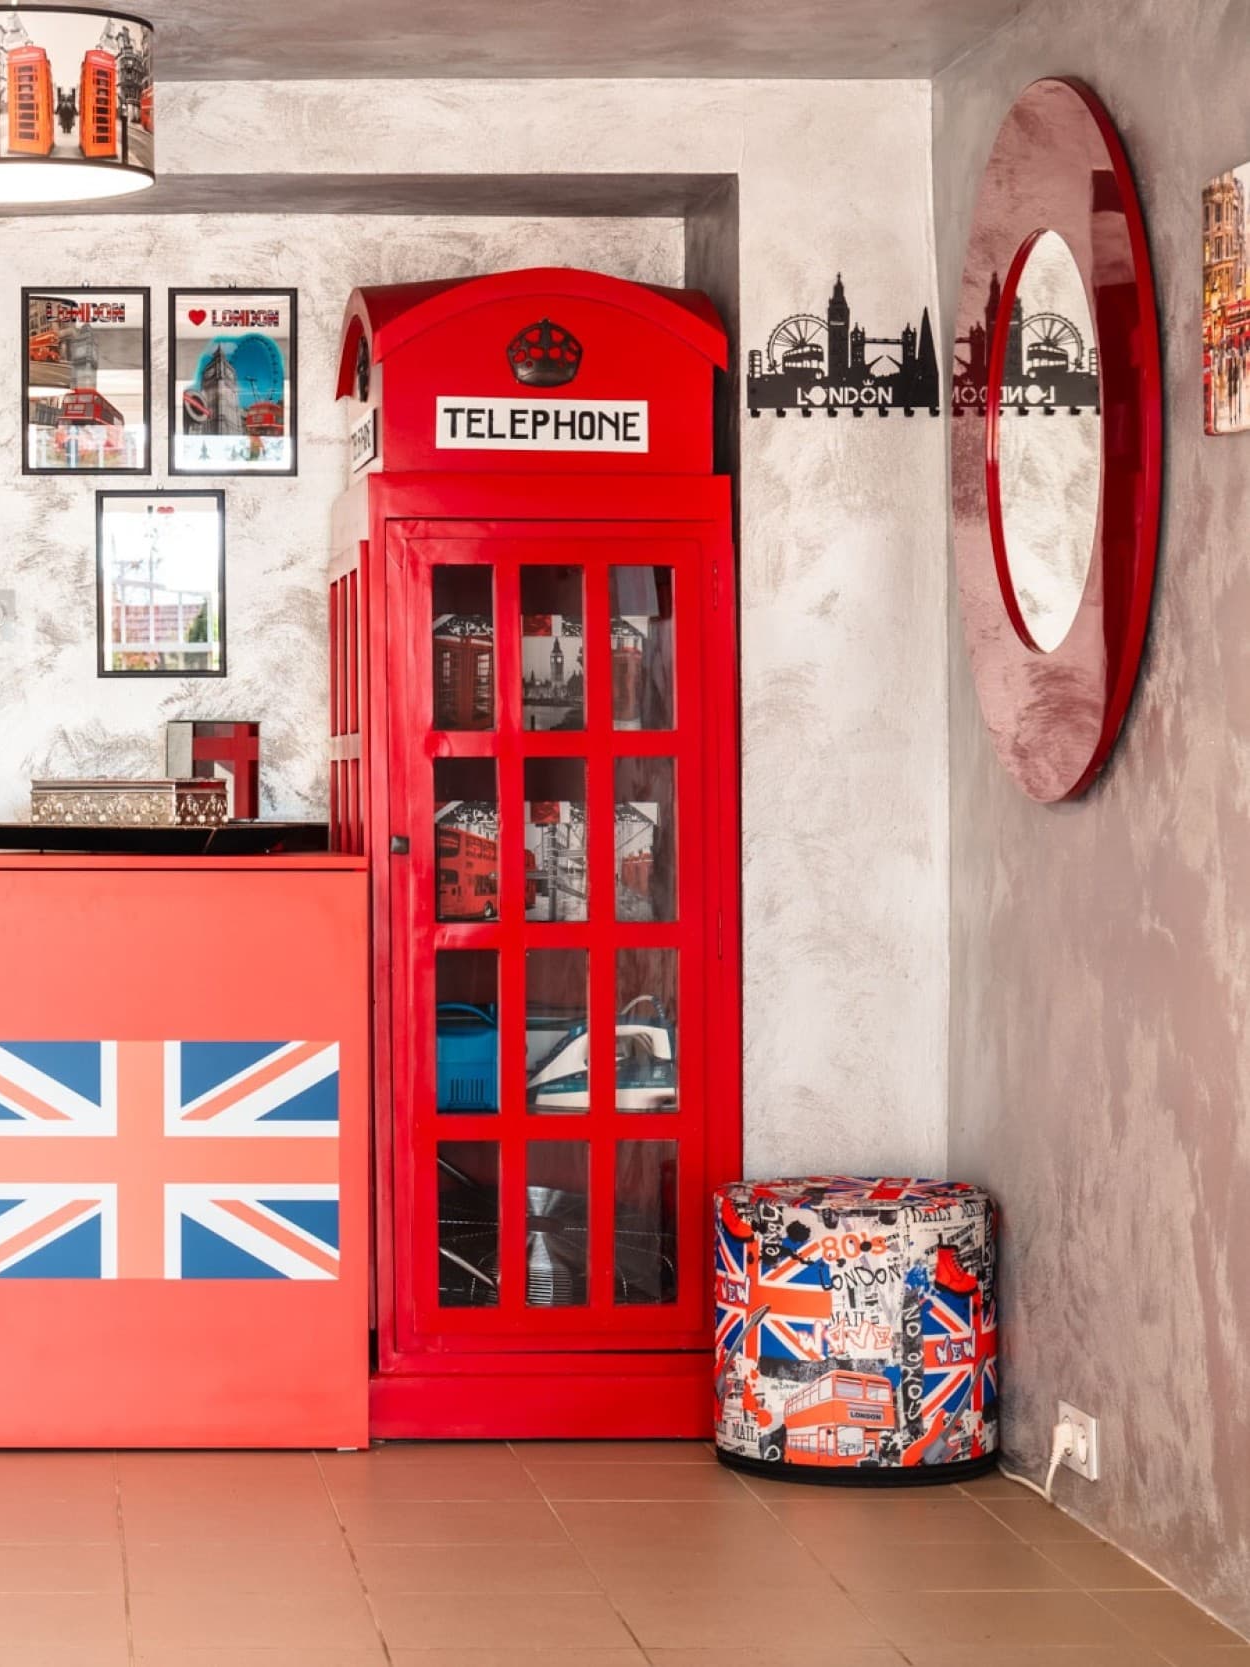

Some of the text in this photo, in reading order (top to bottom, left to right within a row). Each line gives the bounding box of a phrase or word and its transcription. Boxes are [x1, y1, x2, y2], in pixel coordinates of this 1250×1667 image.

[45, 303, 125, 323] LONDON
[212, 309, 280, 328] LONDON
[797, 386, 893, 405] LONDON
[443, 407, 641, 442] TELEPHONE
[818, 1262, 902, 1291] LONDON
[849, 1409, 883, 1421] LONDON
[731, 1421, 758, 1443] MAIL
